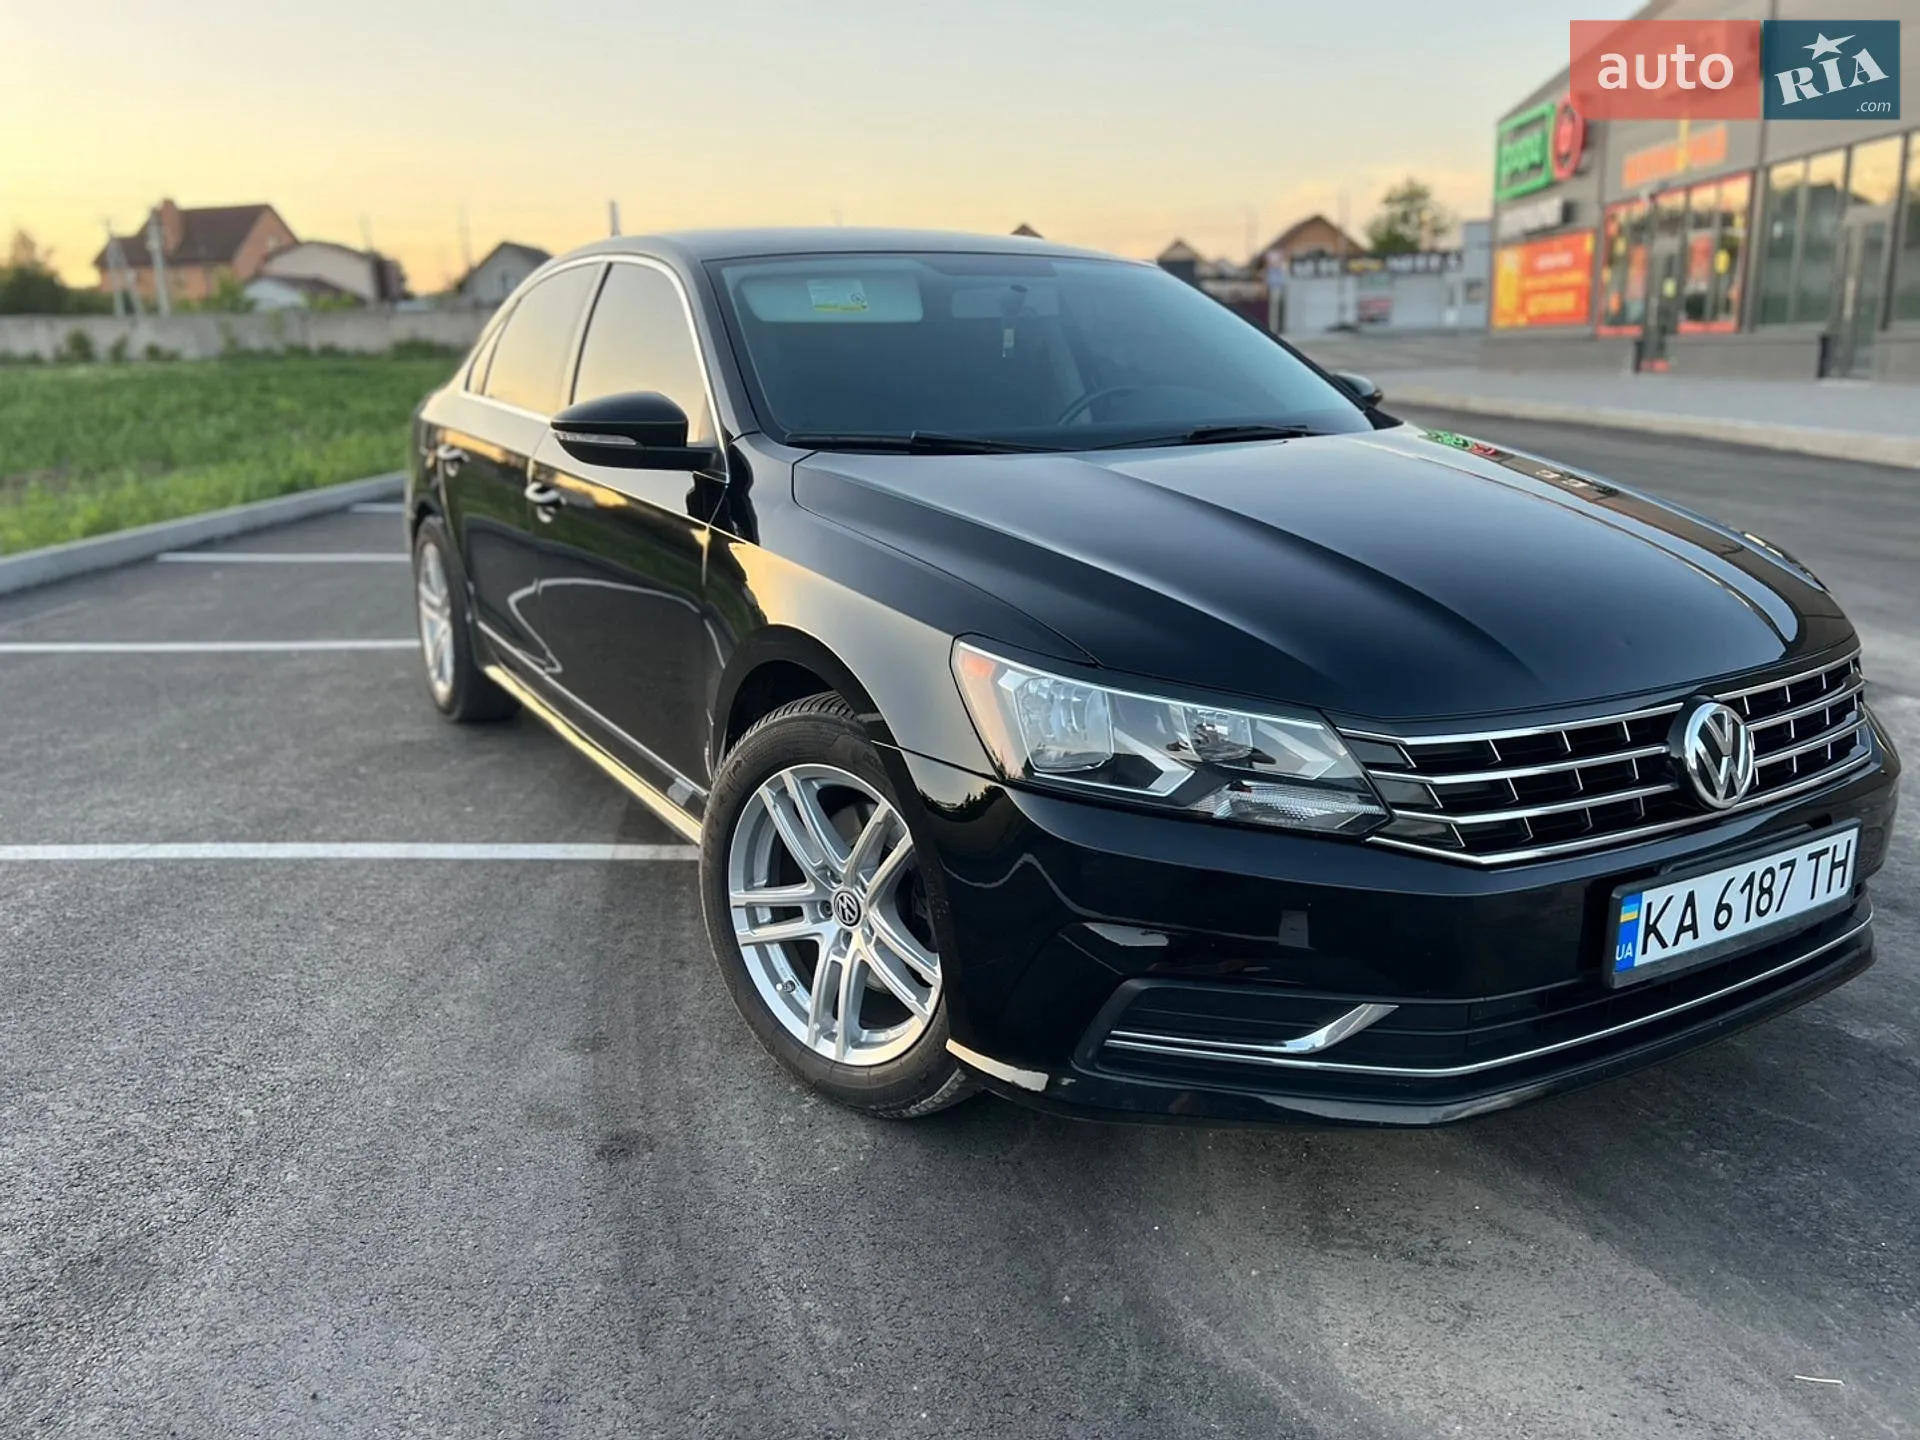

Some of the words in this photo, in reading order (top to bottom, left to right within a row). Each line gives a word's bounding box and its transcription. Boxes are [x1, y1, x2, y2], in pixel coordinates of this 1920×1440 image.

[1641, 889, 1700, 956] KA
[1713, 857, 1797, 932] 6187
[1807, 839, 1852, 901] TH
[1615, 942, 1633, 961] UA
